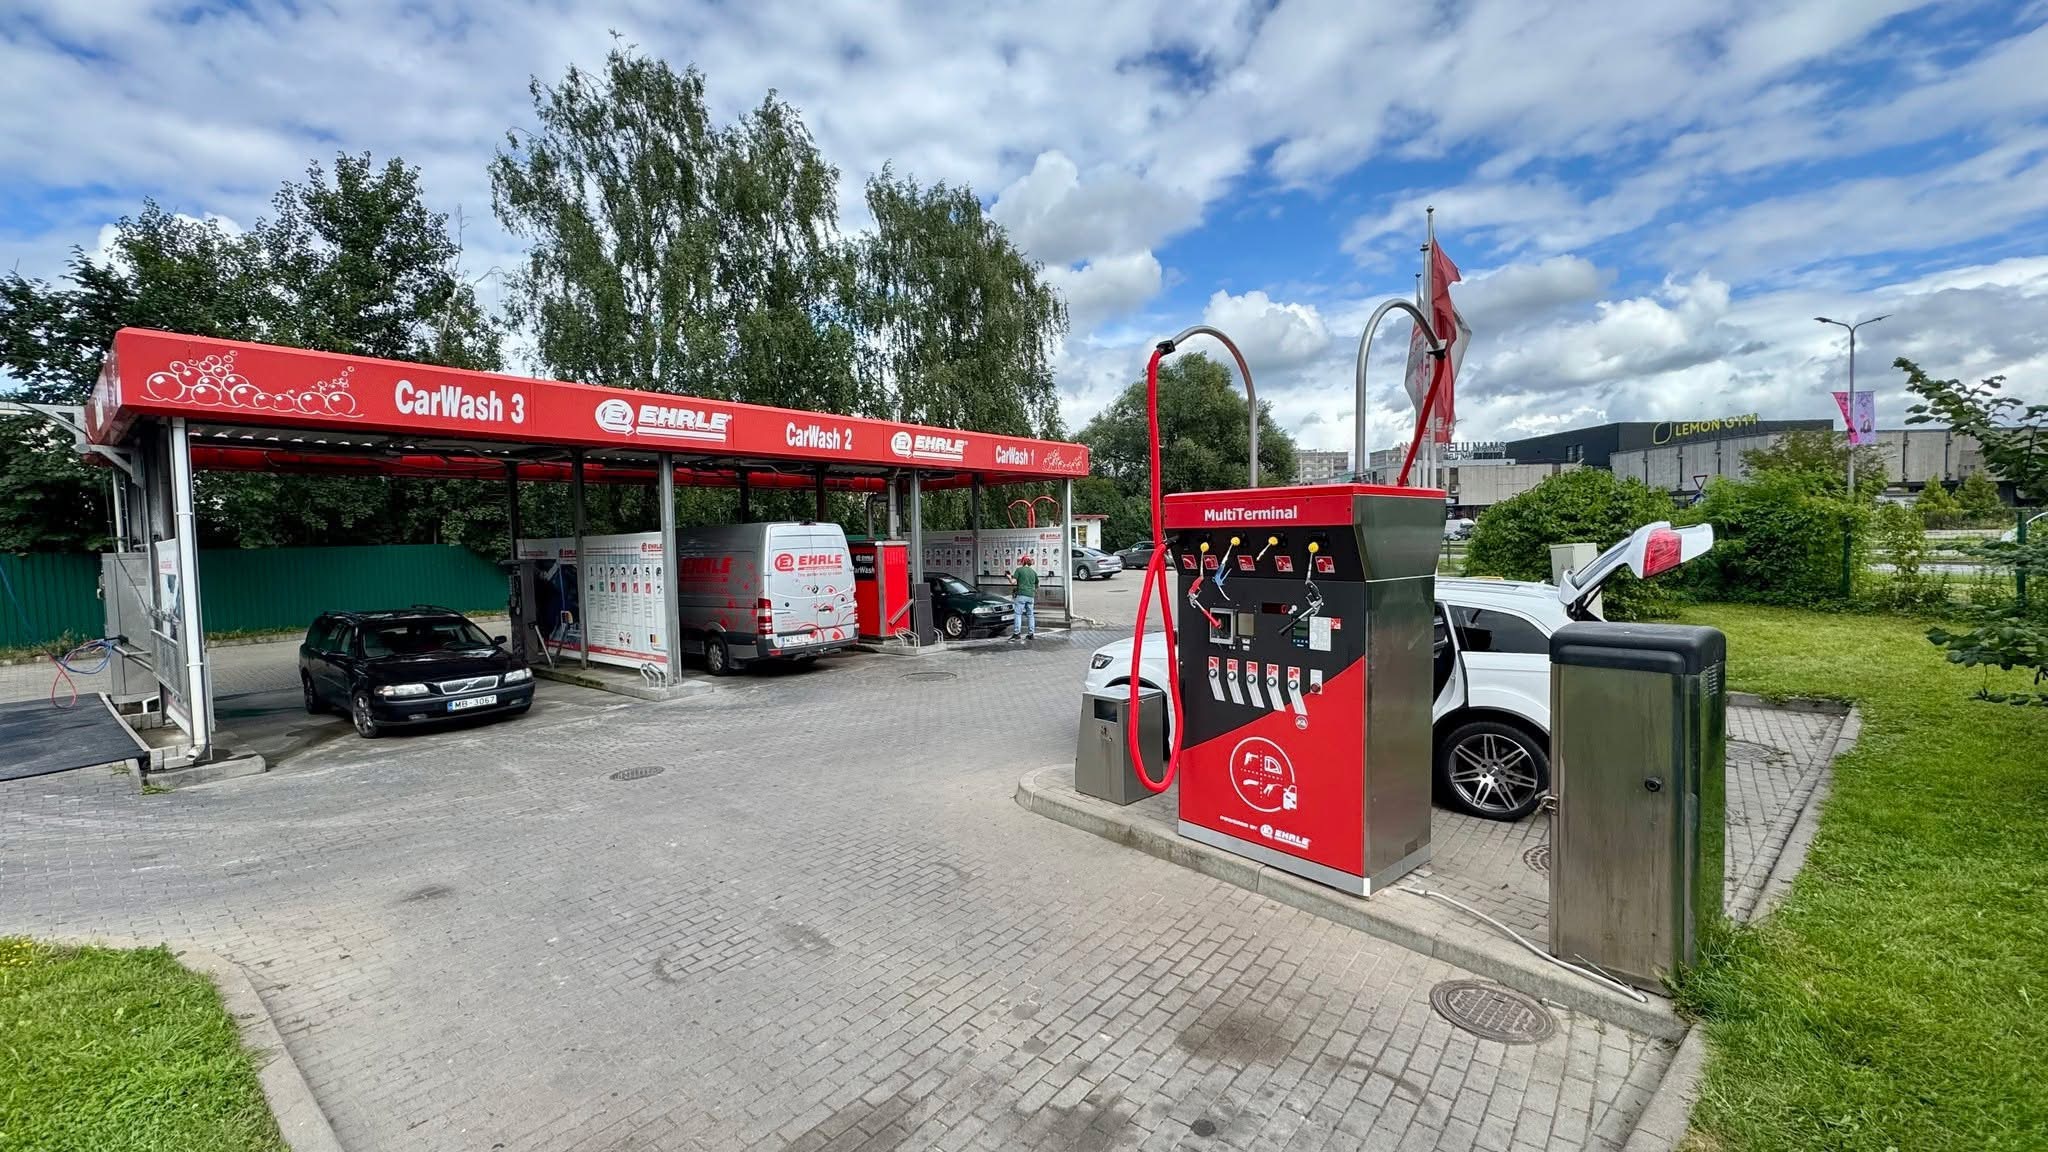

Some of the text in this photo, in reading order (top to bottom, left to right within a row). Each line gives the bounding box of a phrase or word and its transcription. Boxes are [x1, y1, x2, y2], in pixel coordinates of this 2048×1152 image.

[395, 380, 525, 424] CarWash 3
[638, 405, 728, 432] EHRLE
[1675, 413, 1758, 436] LEMON GYM
[786, 421, 852, 450] CarWash 2
[914, 435, 964, 454] EHRLE
[995, 445, 1035, 465] CarWash 1
[1204, 505, 1297, 521] MultiTerminal
[798, 554, 843, 566] EHRLE
[853, 566, 875, 574] arWash
[1275, 830, 1310, 846] EHRLE
